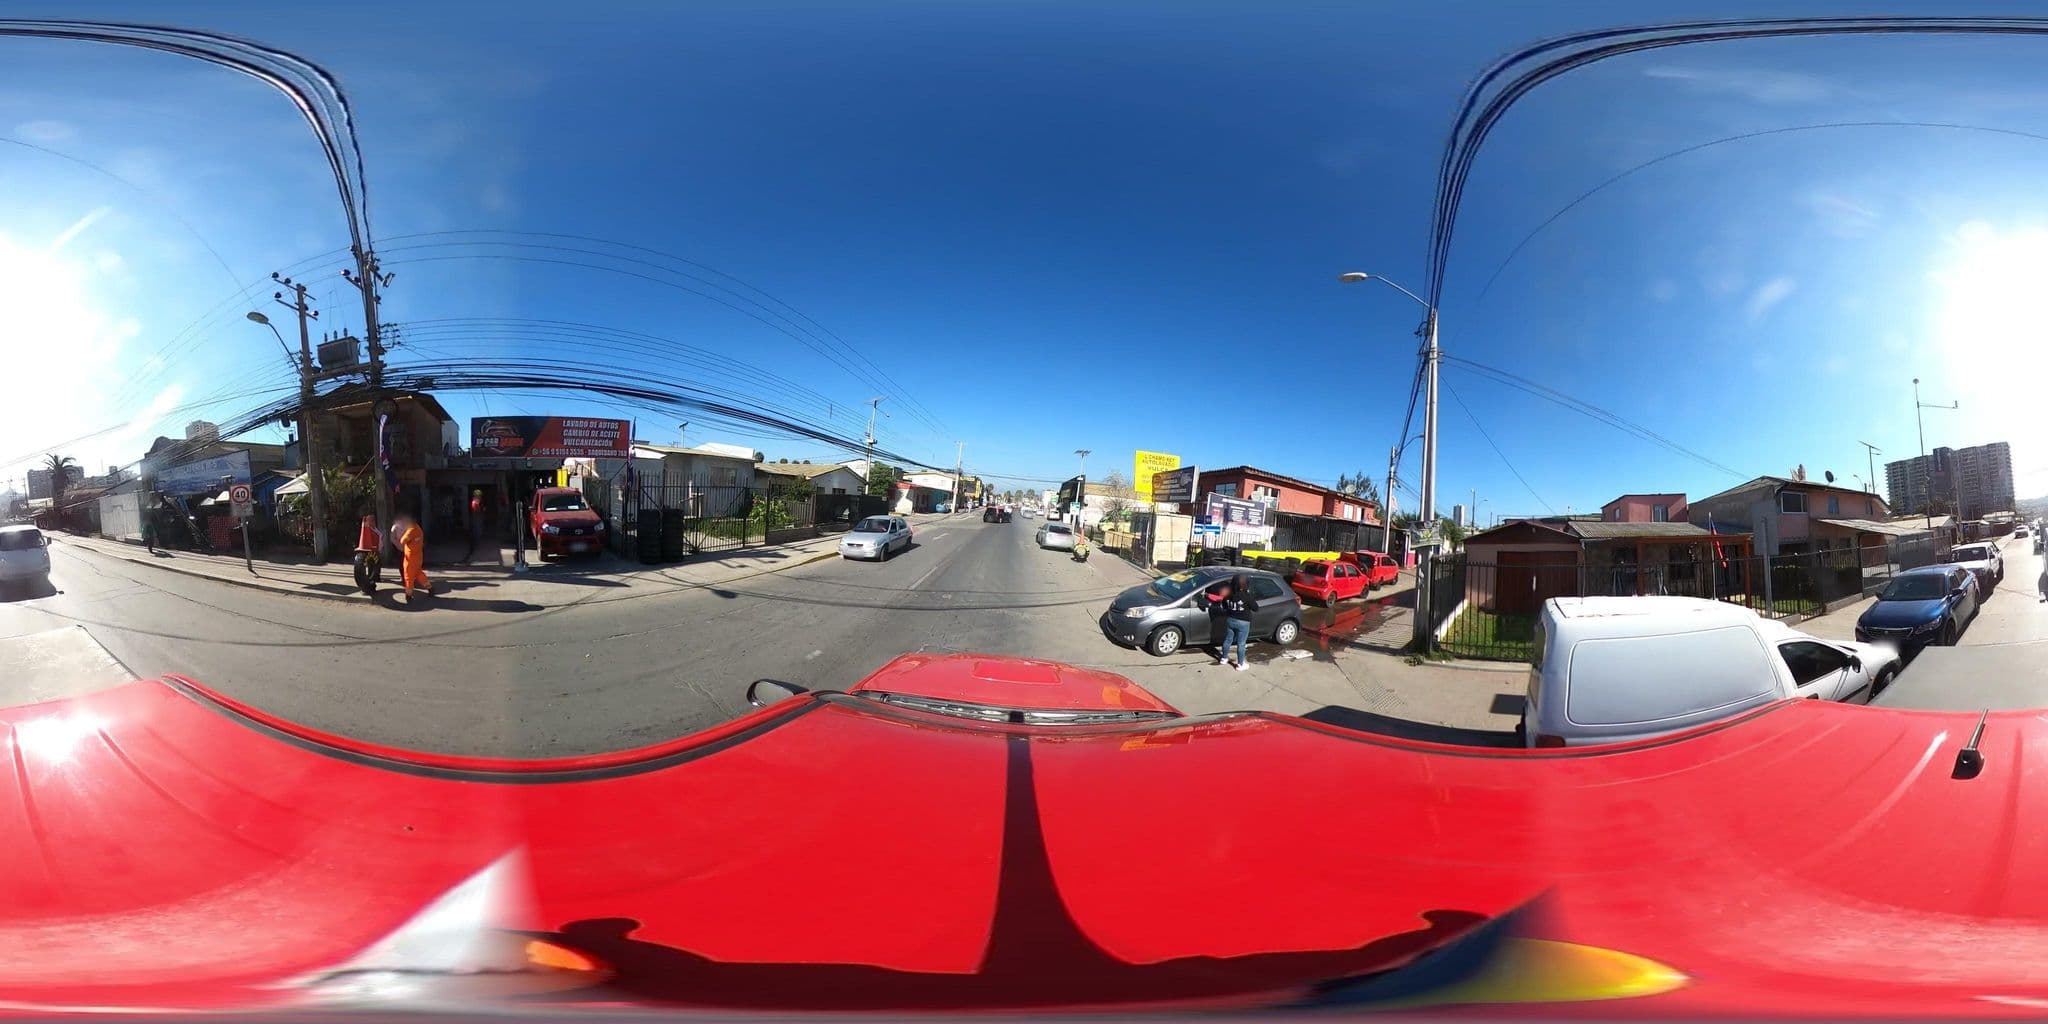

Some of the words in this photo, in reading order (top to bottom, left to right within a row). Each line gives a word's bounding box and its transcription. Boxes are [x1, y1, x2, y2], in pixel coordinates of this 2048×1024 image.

[563, 420, 588, 428] LAVADO
[589, 421, 597, 429] DE
[598, 422, 619, 430] AUTOS
[563, 429, 590, 437] CAMBIO
[591, 430, 598, 438] DE
[599, 431, 620, 439] ACEITE
